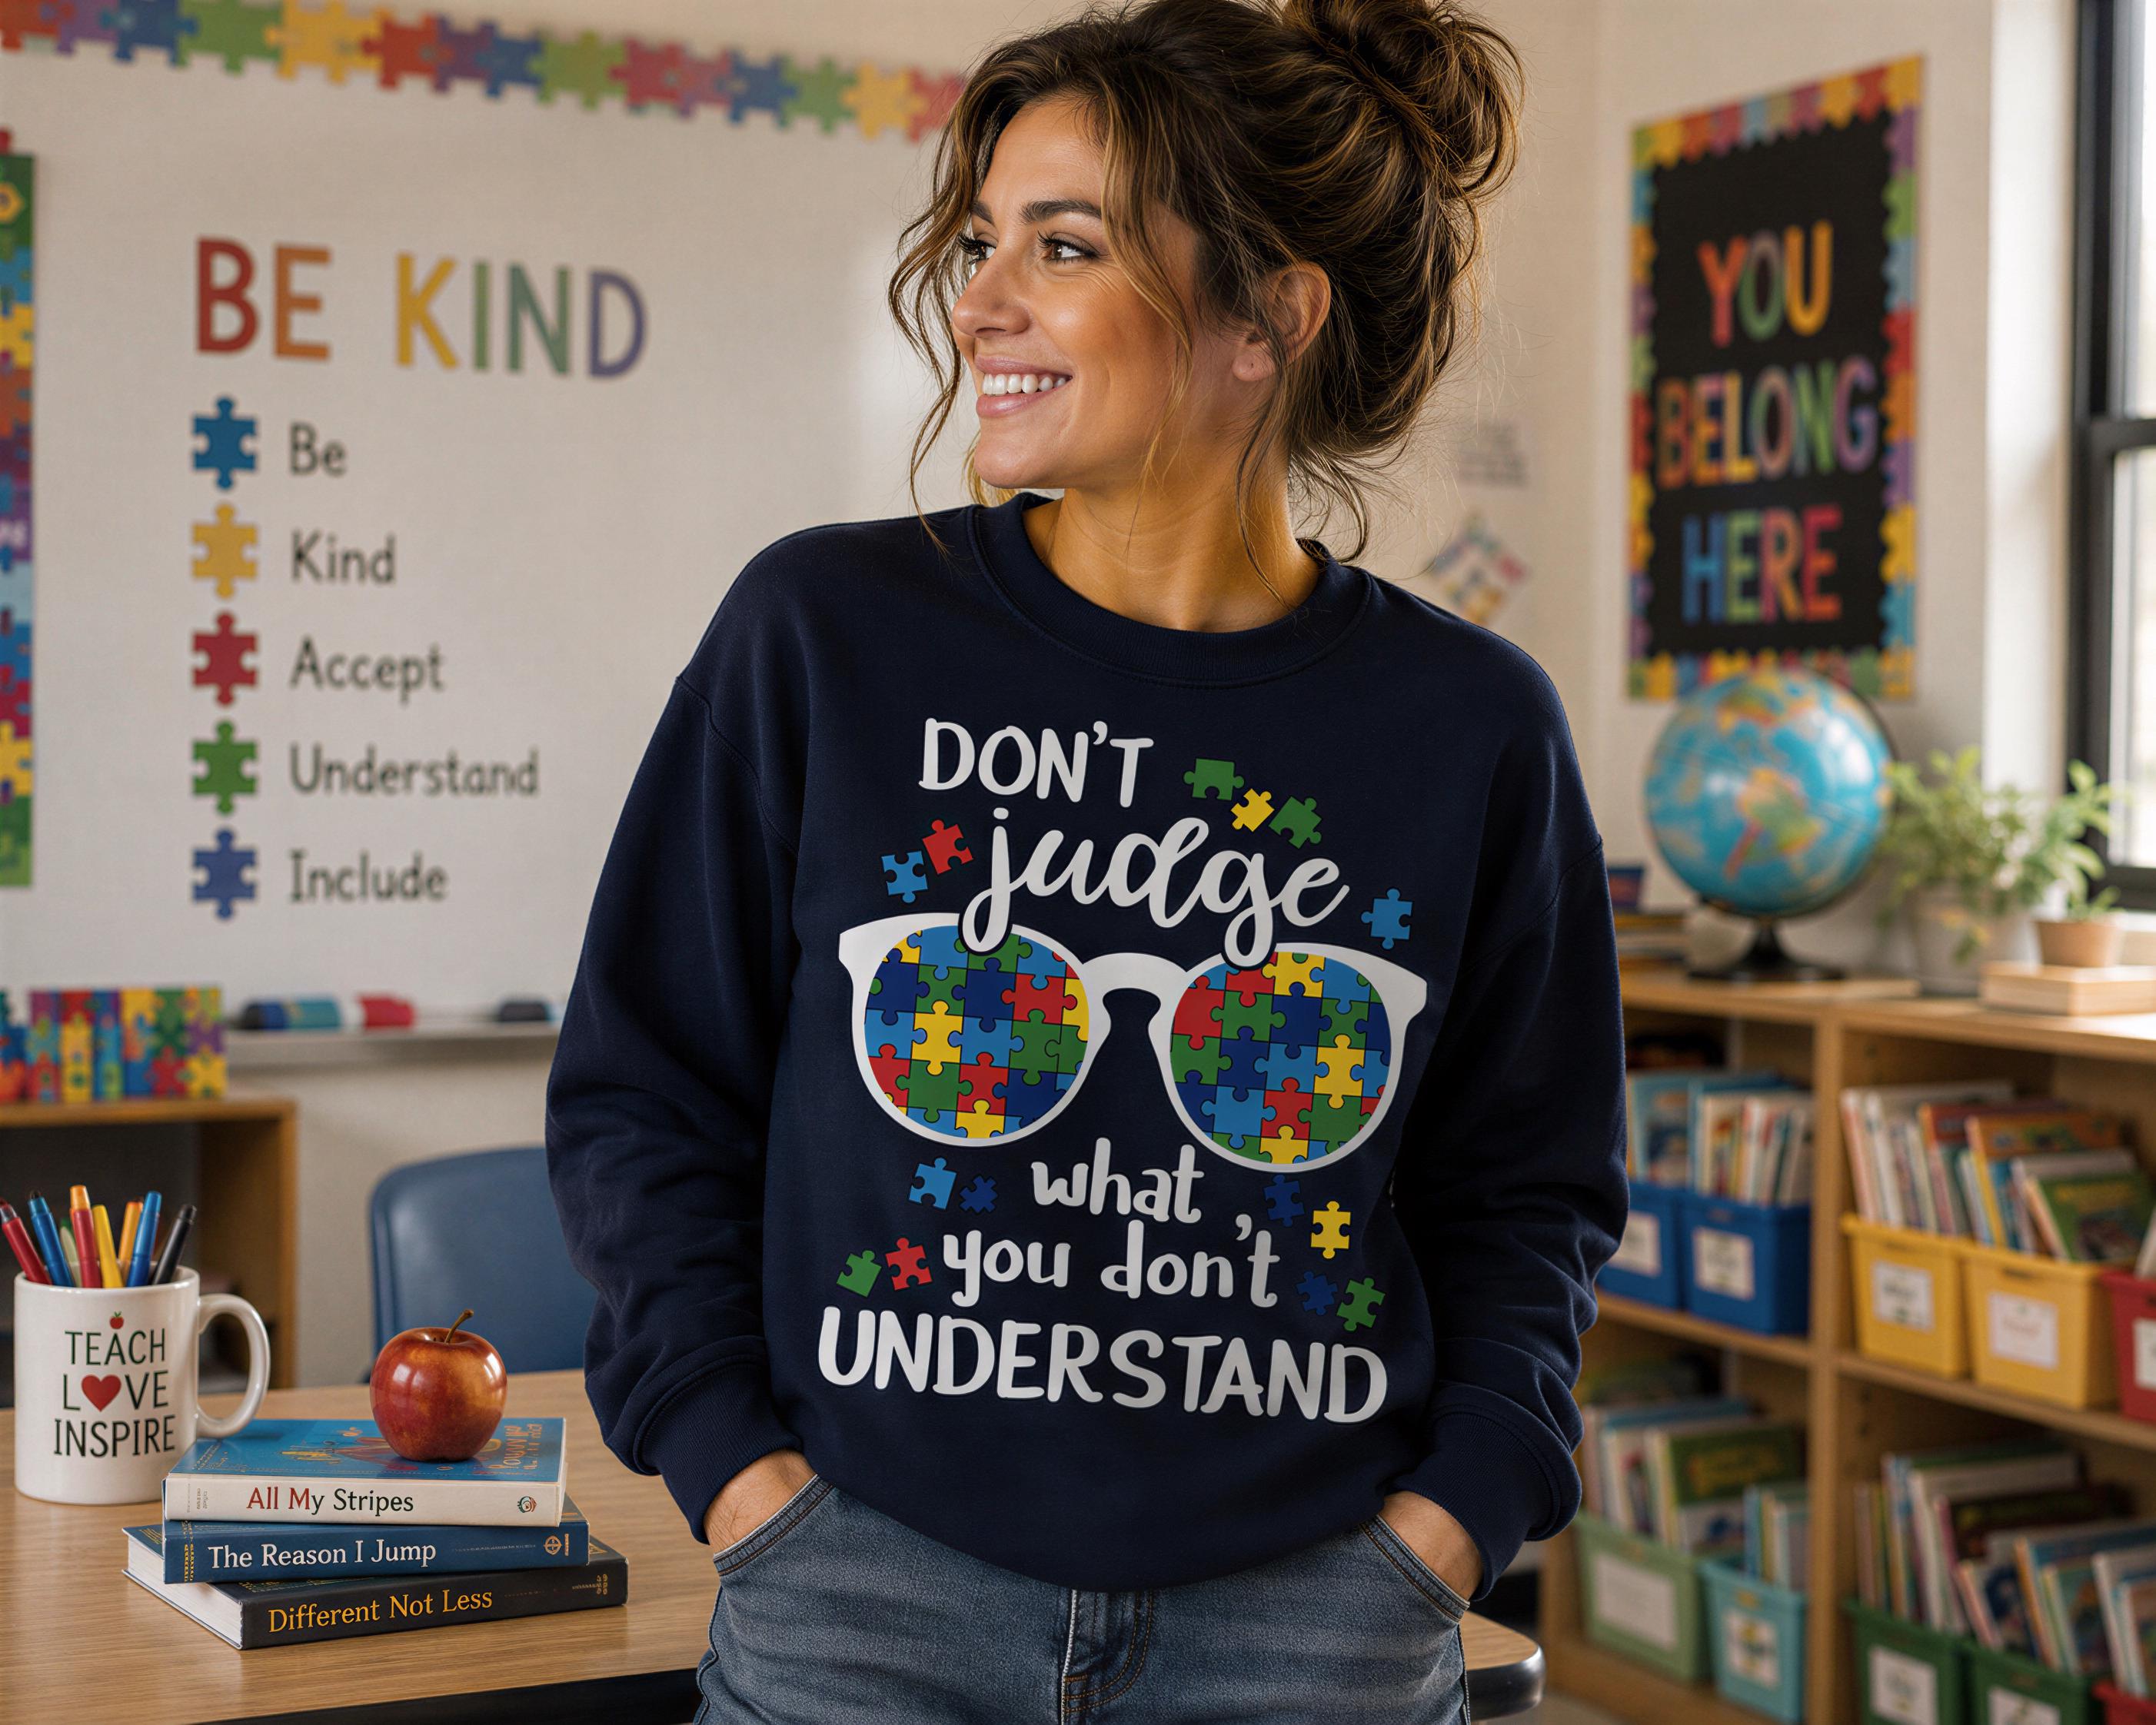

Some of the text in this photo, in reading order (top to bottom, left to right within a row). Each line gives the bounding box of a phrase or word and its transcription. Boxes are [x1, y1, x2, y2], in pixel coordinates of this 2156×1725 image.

[196, 237, 647, 379] BE KIND
[1698, 220, 1833, 347] YOU
[290, 422, 347, 476] Be
[1657, 355, 1877, 488] BELONG
[291, 532, 396, 584] Kind
[1682, 503, 1842, 623] HERE
[290, 637, 444, 703] Accept
[290, 746, 539, 796] Understand
[919, 718, 1153, 807] DON'T
[290, 849, 448, 902] Include
[962, 808, 1350, 967] judge
[1031, 1138, 1204, 1223] what
[943, 1215, 1279, 1307] you don't
[65, 1328, 165, 1365] TEACH
[819, 1307, 1387, 1422] UNDERSTAND
[63, 1370, 169, 1411] LVE
[54, 1415, 176, 1457] INSPIRE
[246, 1487, 414, 1517] All My Stripes
[208, 1544, 252, 1569] The
[261, 1544, 347, 1567] Reason
[354, 1540, 364, 1563] I
[371, 1539, 437, 1567] Jump
[268, 1589, 493, 1633] Different Not Less
